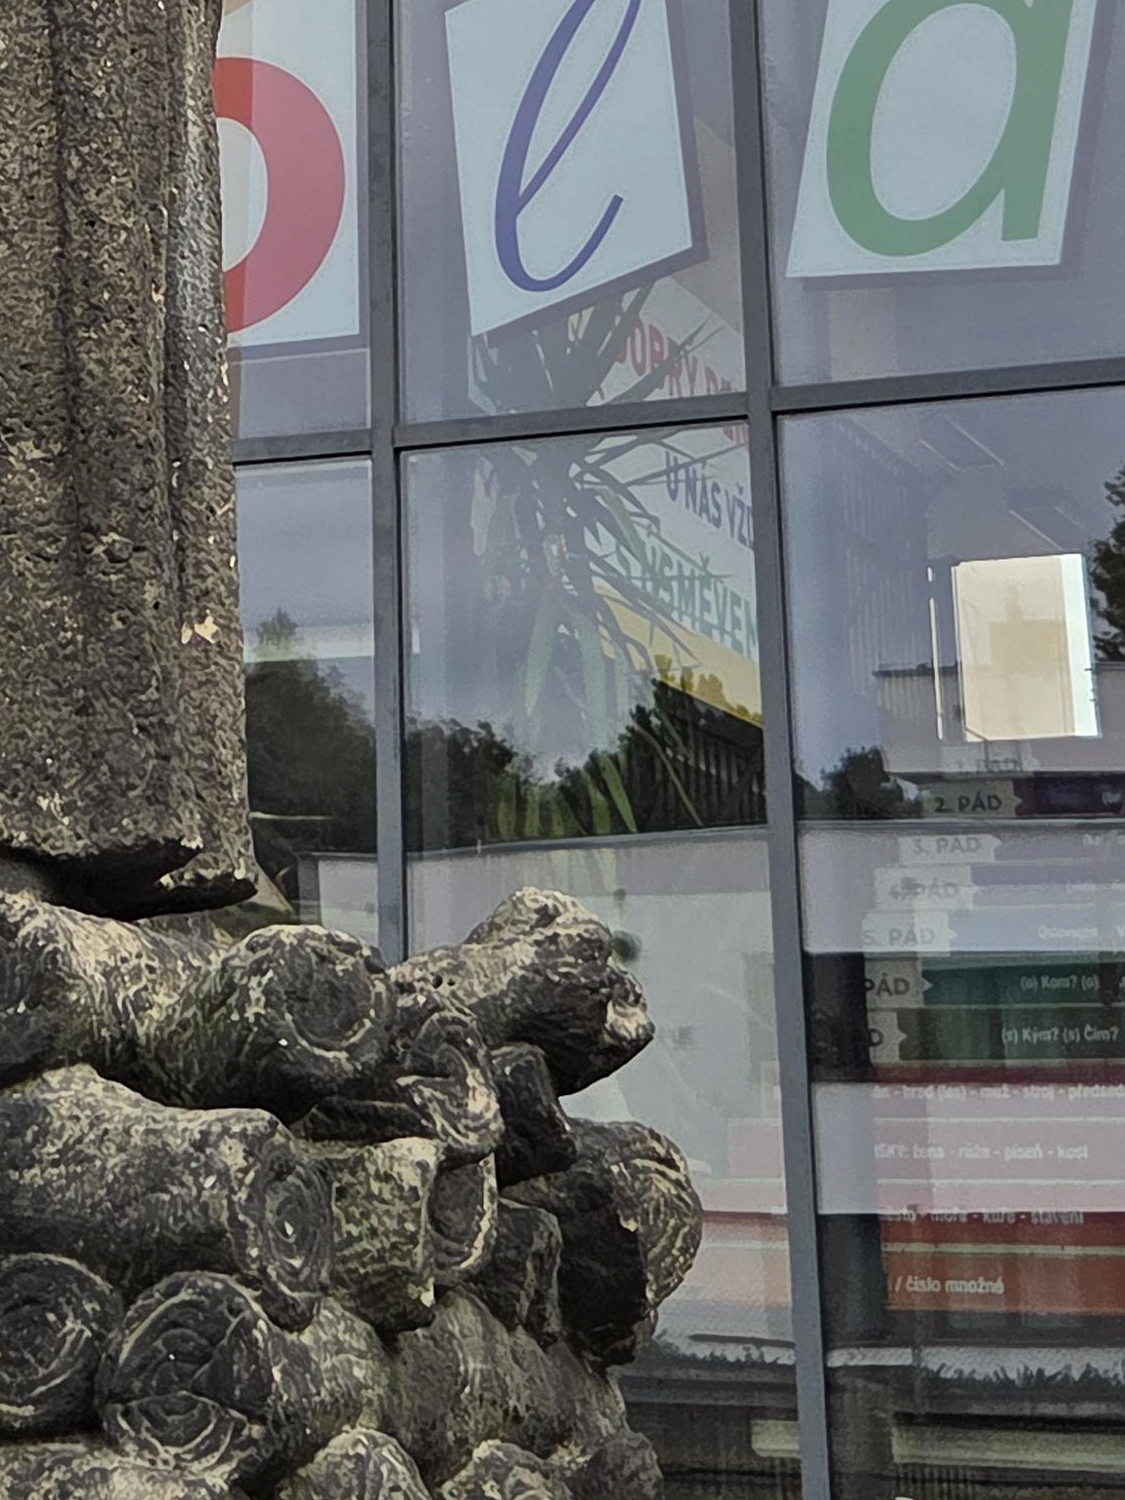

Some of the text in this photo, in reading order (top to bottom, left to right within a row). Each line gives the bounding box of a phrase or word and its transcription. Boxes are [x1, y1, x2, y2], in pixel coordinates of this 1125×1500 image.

[958, 792, 1003, 812] PÁD
[888, 920, 935, 946] PÁD
[1022, 1027, 1059, 1046] Kým?
[945, 1275, 1005, 1295] množné
